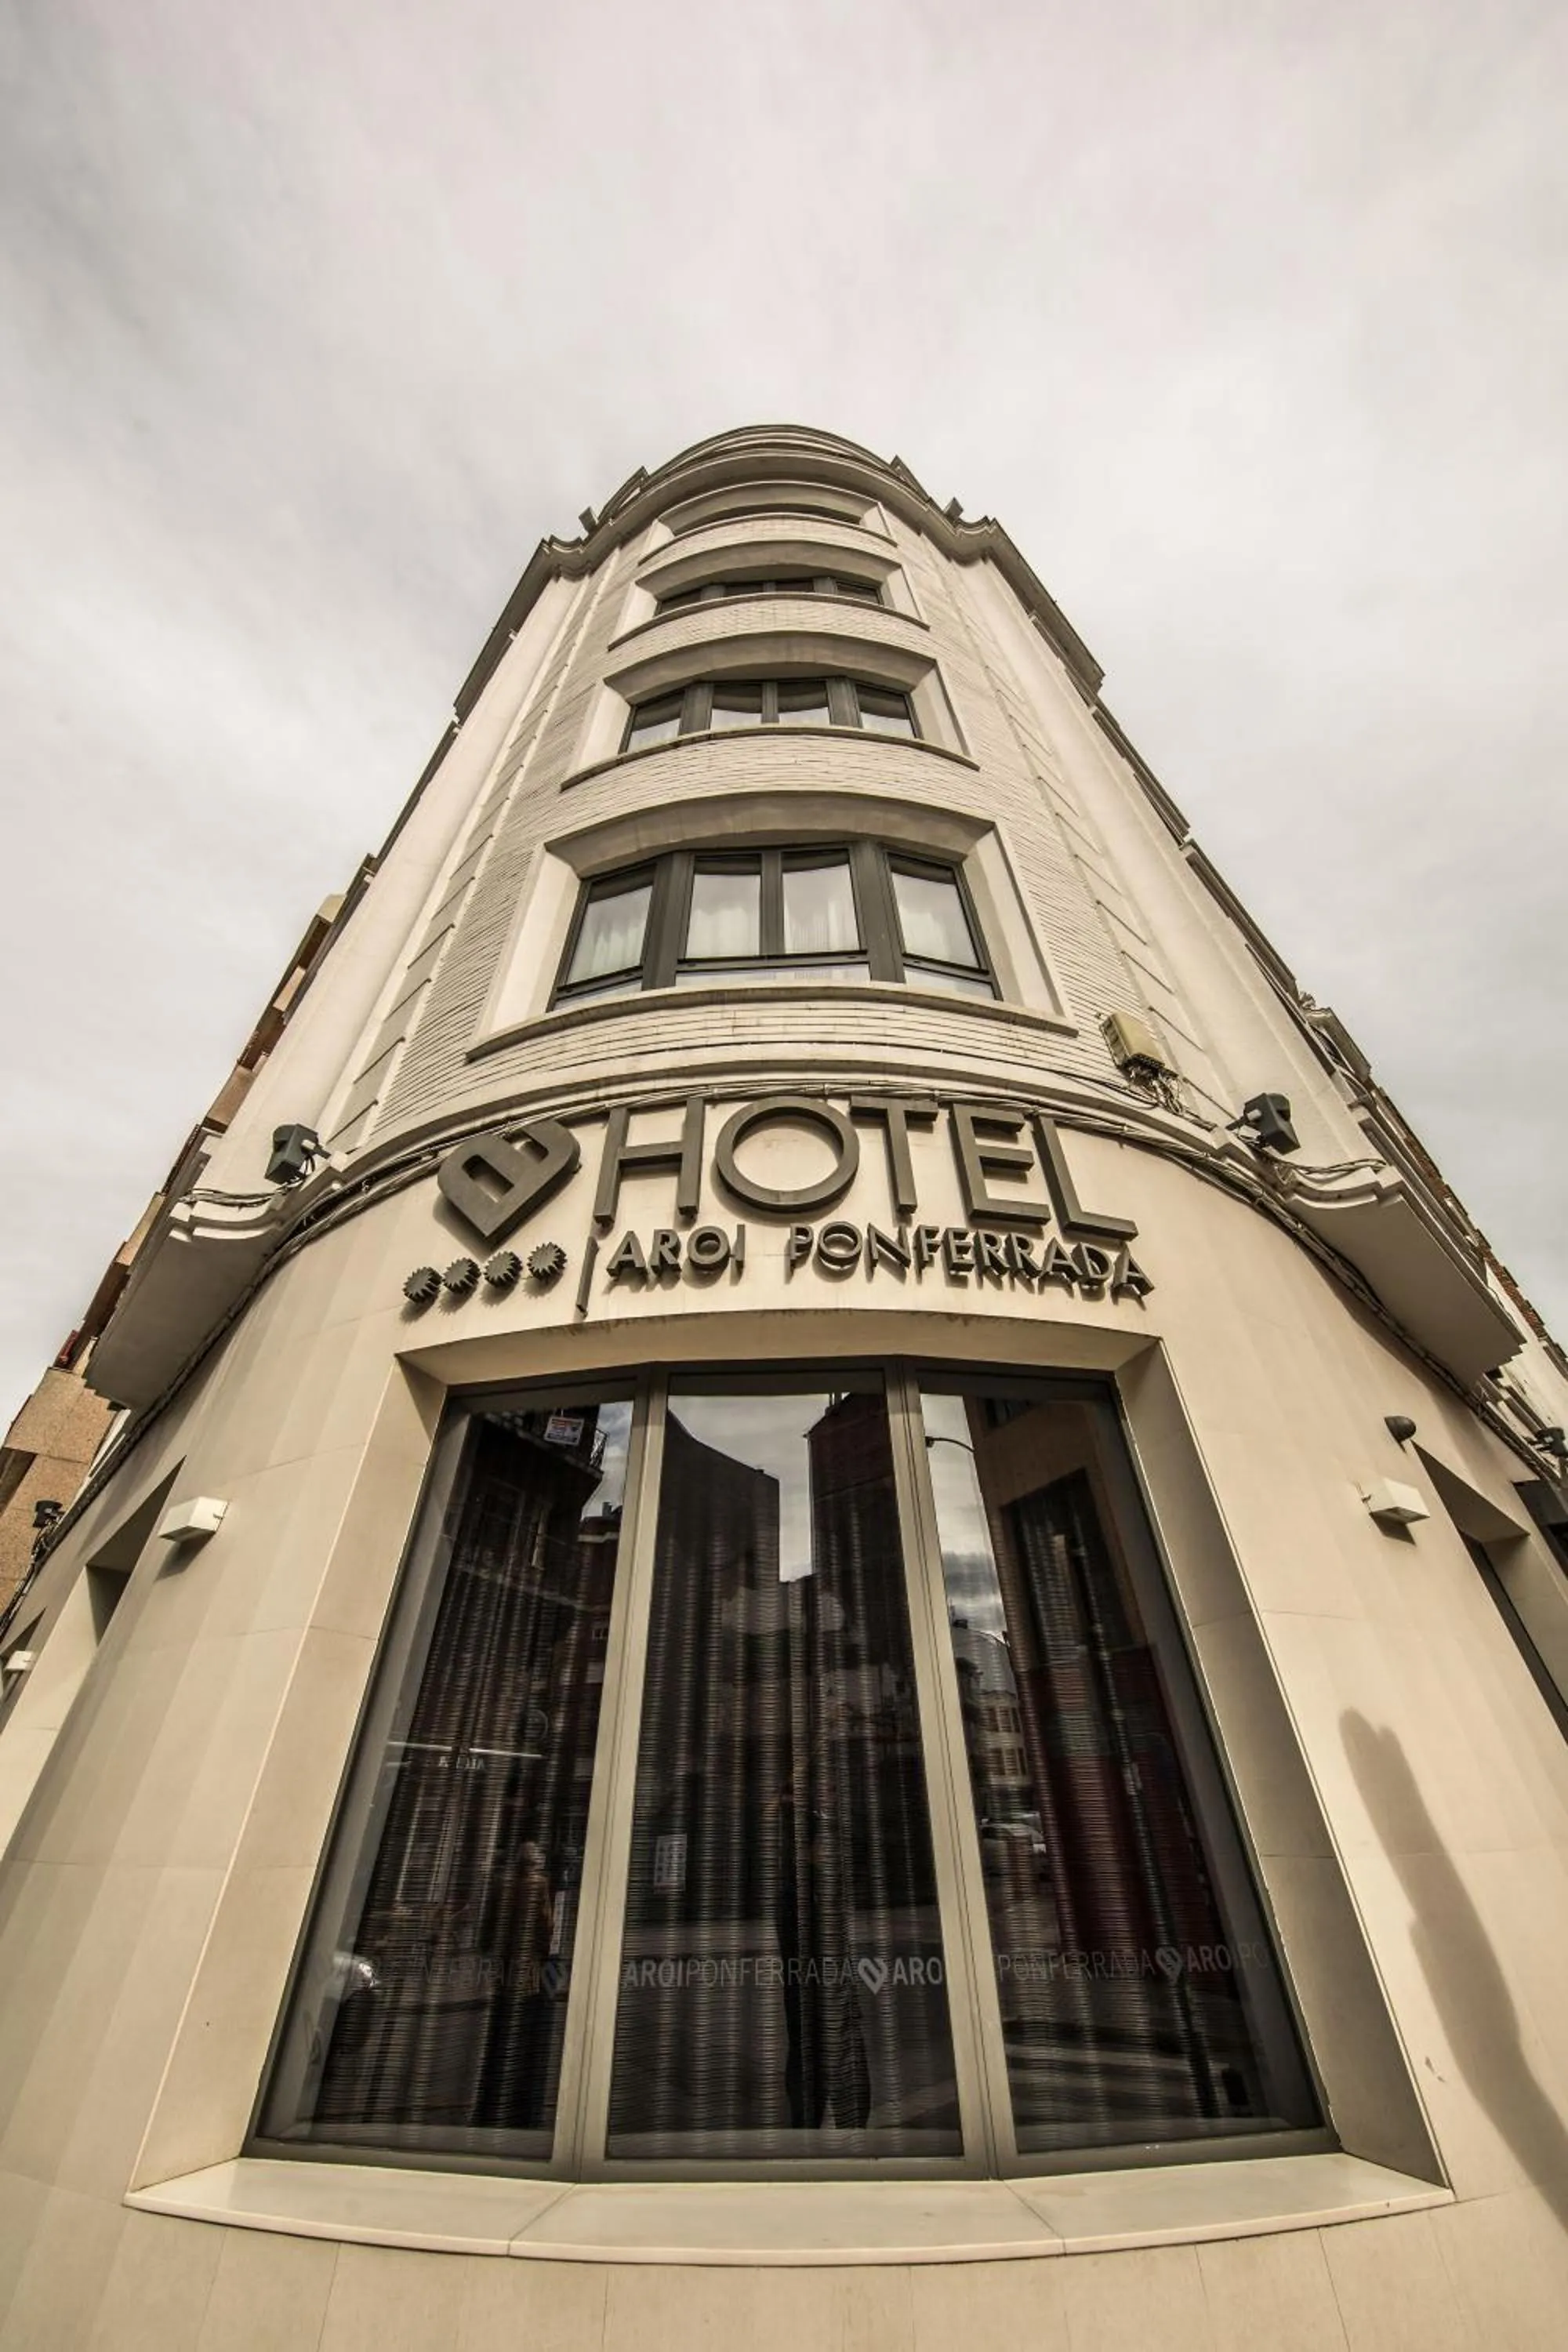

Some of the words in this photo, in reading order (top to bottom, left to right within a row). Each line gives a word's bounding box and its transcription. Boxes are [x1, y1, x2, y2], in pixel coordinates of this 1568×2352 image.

[592, 1097, 1138, 1240] HOTEL
[605, 1224, 746, 1283] AROI
[787, 1220, 1156, 1298] PONFERRADA
